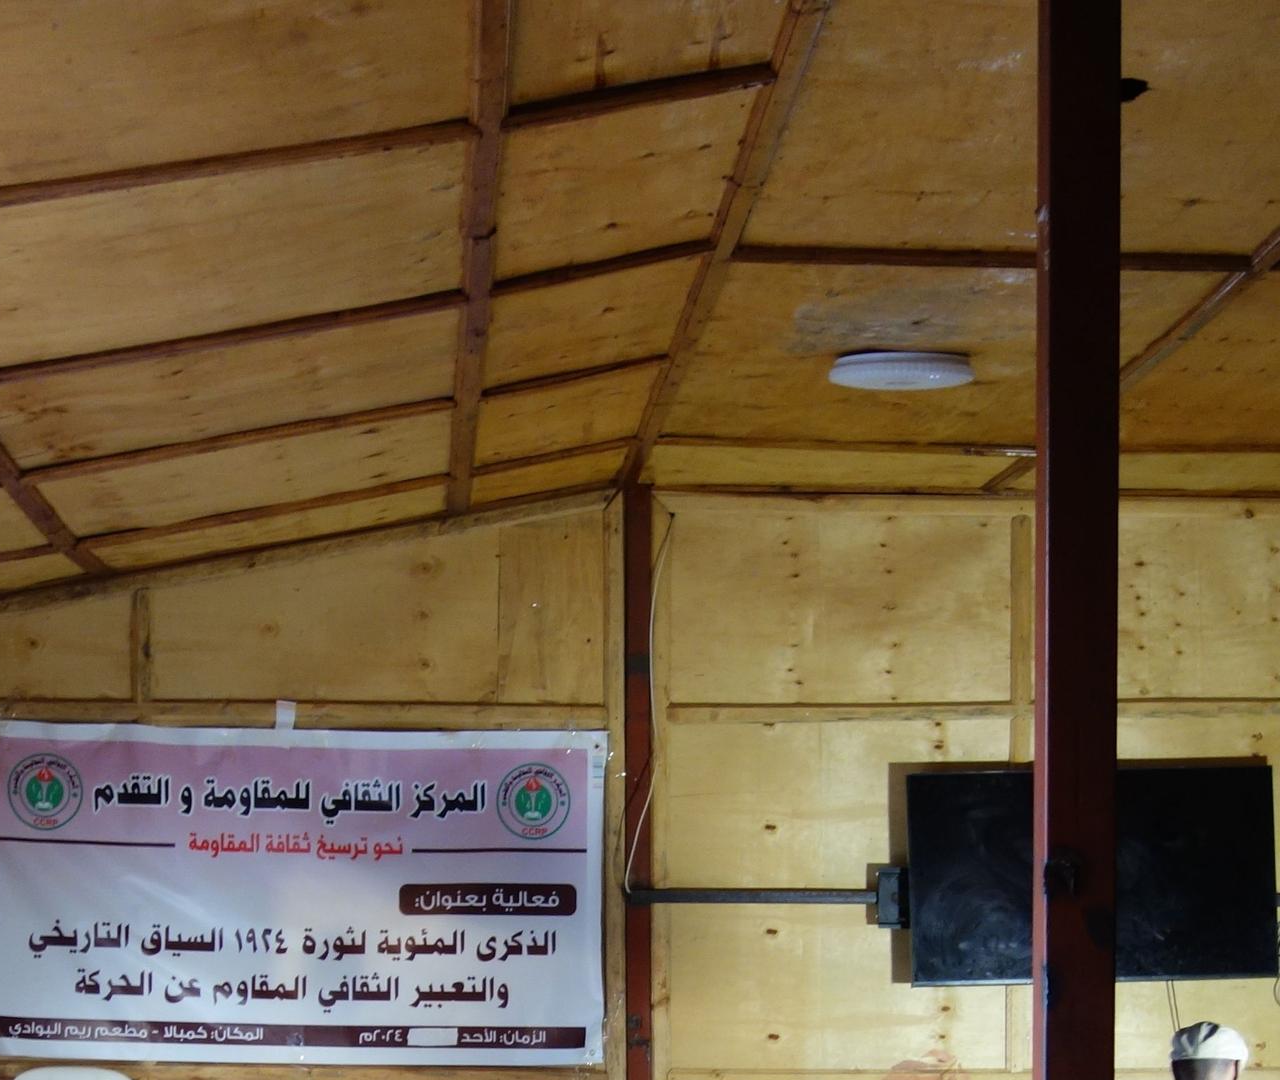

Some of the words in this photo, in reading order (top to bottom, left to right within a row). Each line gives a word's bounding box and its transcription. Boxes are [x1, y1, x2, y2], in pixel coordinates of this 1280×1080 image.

[93, 775, 170, 812] التقدم
[180, 783, 193, 814] و
[204, 778, 310, 817] للمقاومة
[321, 779, 401, 825] الثقافي
[410, 781, 486, 819] المركز
[188, 832, 260, 858] المقاومة
[265, 831, 310, 854] ثقافة
[521, 827, 548, 836] CCRP
[316, 836, 368, 860] ترسيخ
[373, 835, 404, 861] نحو
[415, 889, 487, 912] بعنوان:
[492, 888, 560, 912] فعالية
[28, 919, 129, 958] التاريخي
[141, 924, 223, 957] السياق
[234, 927, 288, 954] ١٩٢٤
[302, 926, 366, 960] لثورة
[377, 928, 465, 961] المئوية
[476, 929, 557, 962] الذكرى
[75, 968, 152, 1001] الحركة
[164, 975, 201, 1003] عن
[213, 974, 307, 1005] المقاوم
[318, 972, 399, 1014] الثقافي
[409, 976, 509, 1008] والتعبير
[8, 1022, 61, 1039] البوادي
[64, 1026, 91, 1040] ريم
[95, 1023, 148, 1040] مطعم
[164, 1025, 207, 1041] كمبالا
[211, 1026, 264, 1042] المكان:
[461, 1030, 497, 1044] الأحد
[499, 1030, 547, 1046] الزمان:
